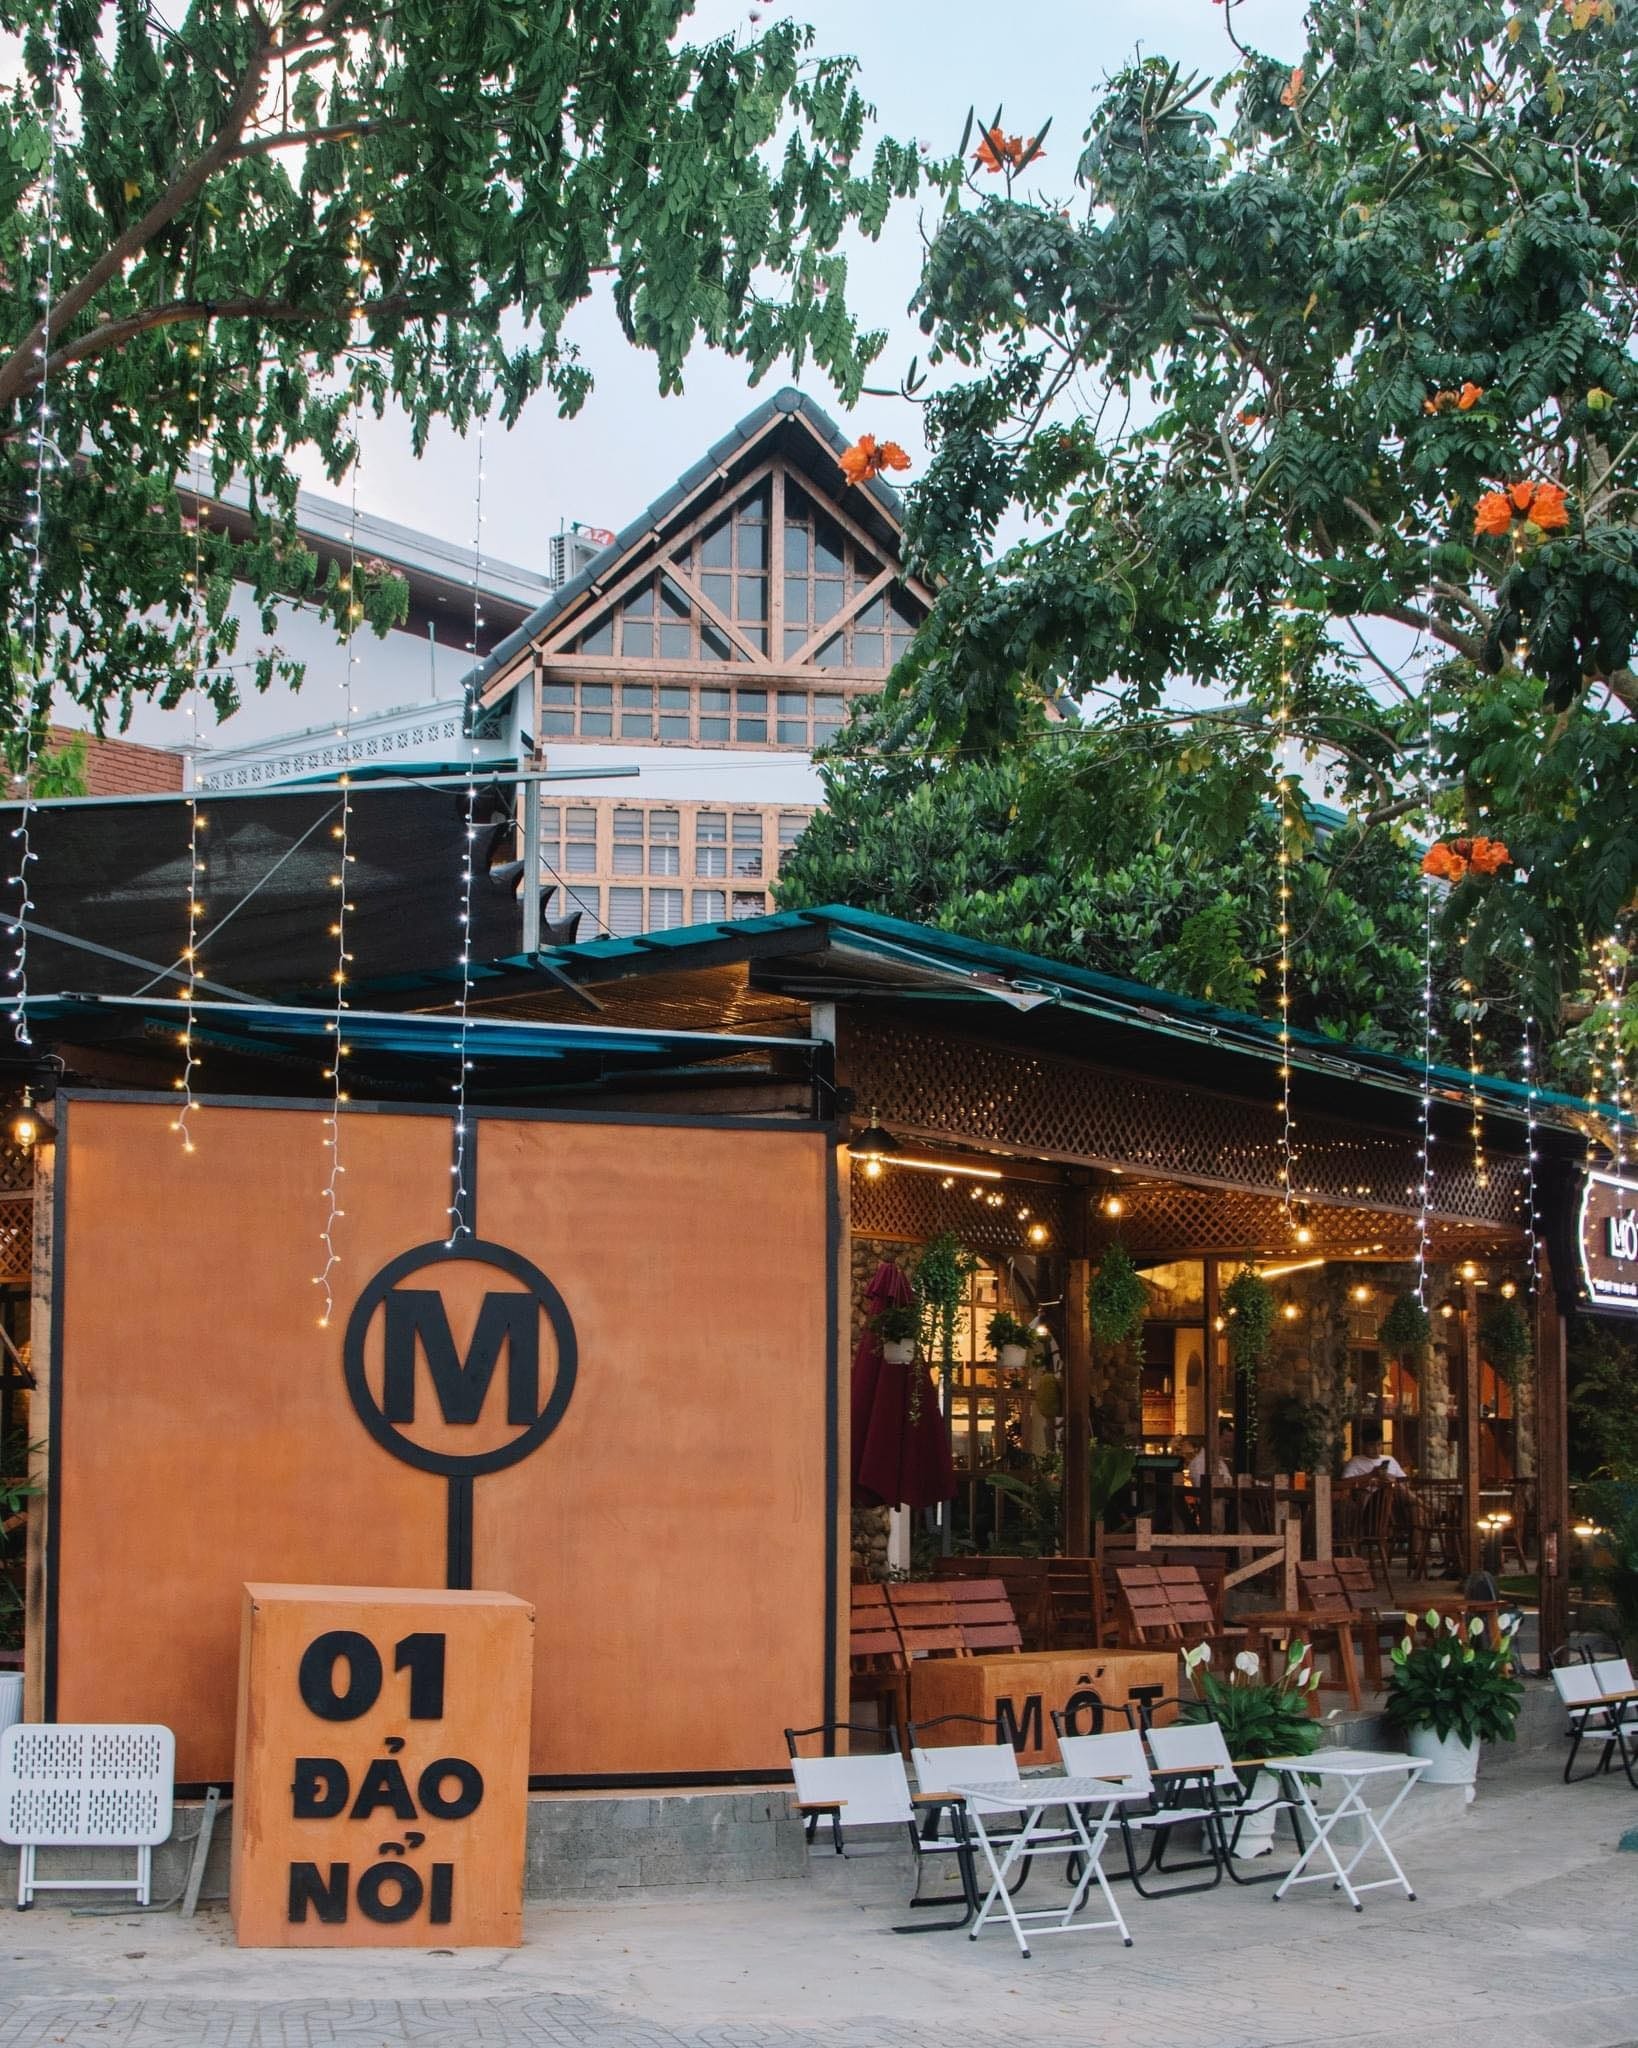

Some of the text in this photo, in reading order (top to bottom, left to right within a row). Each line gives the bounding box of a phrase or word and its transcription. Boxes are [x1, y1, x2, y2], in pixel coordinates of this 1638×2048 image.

[383, 1289, 540, 1426] M
[299, 1630, 446, 1722] 01
[291, 1736, 484, 1820] ĐẢO
[288, 1831, 454, 1925] NỔI
